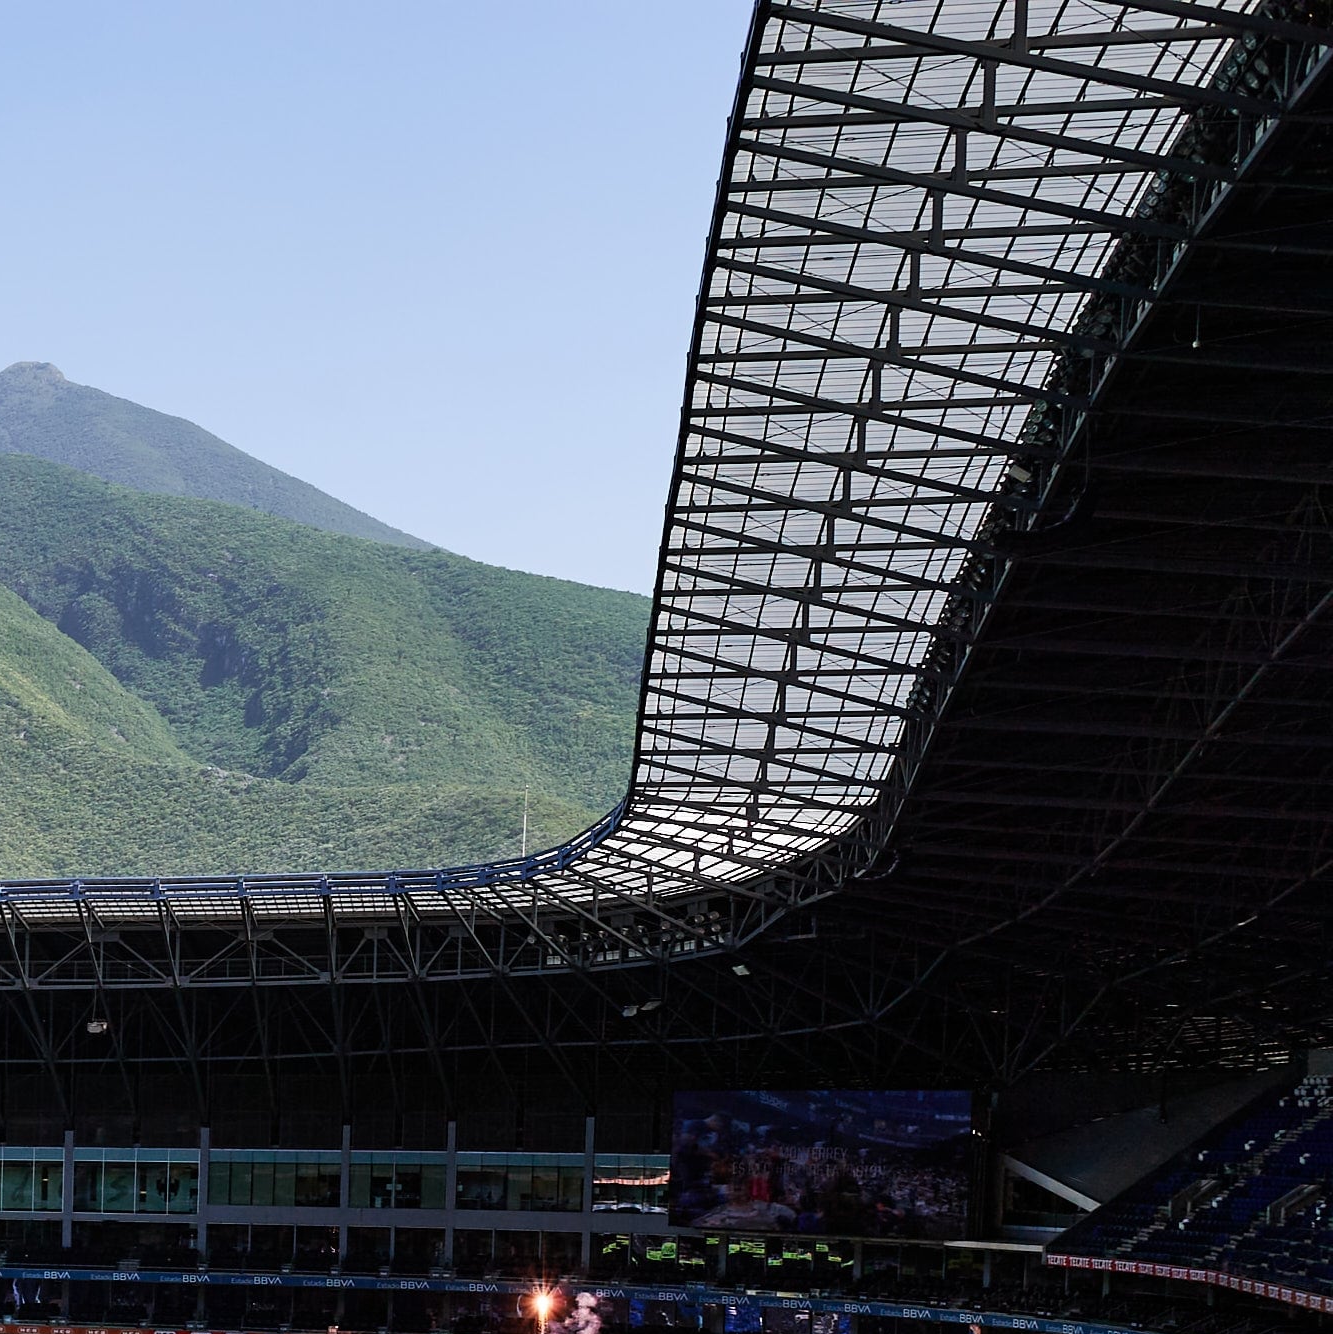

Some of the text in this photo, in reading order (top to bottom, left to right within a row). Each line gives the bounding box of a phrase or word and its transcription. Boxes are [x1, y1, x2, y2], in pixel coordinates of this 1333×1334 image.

[182, 1274, 209, 1282] BBVA
[253, 1276, 281, 1284] BBVA
[326, 1278, 354, 1287] BBVA
[400, 1281, 428, 1289] BBVA
[658, 1292, 687, 1301] BBVA
[782, 1299, 811, 1308] BBVA
[903, 1307, 931, 1317] BBVA
